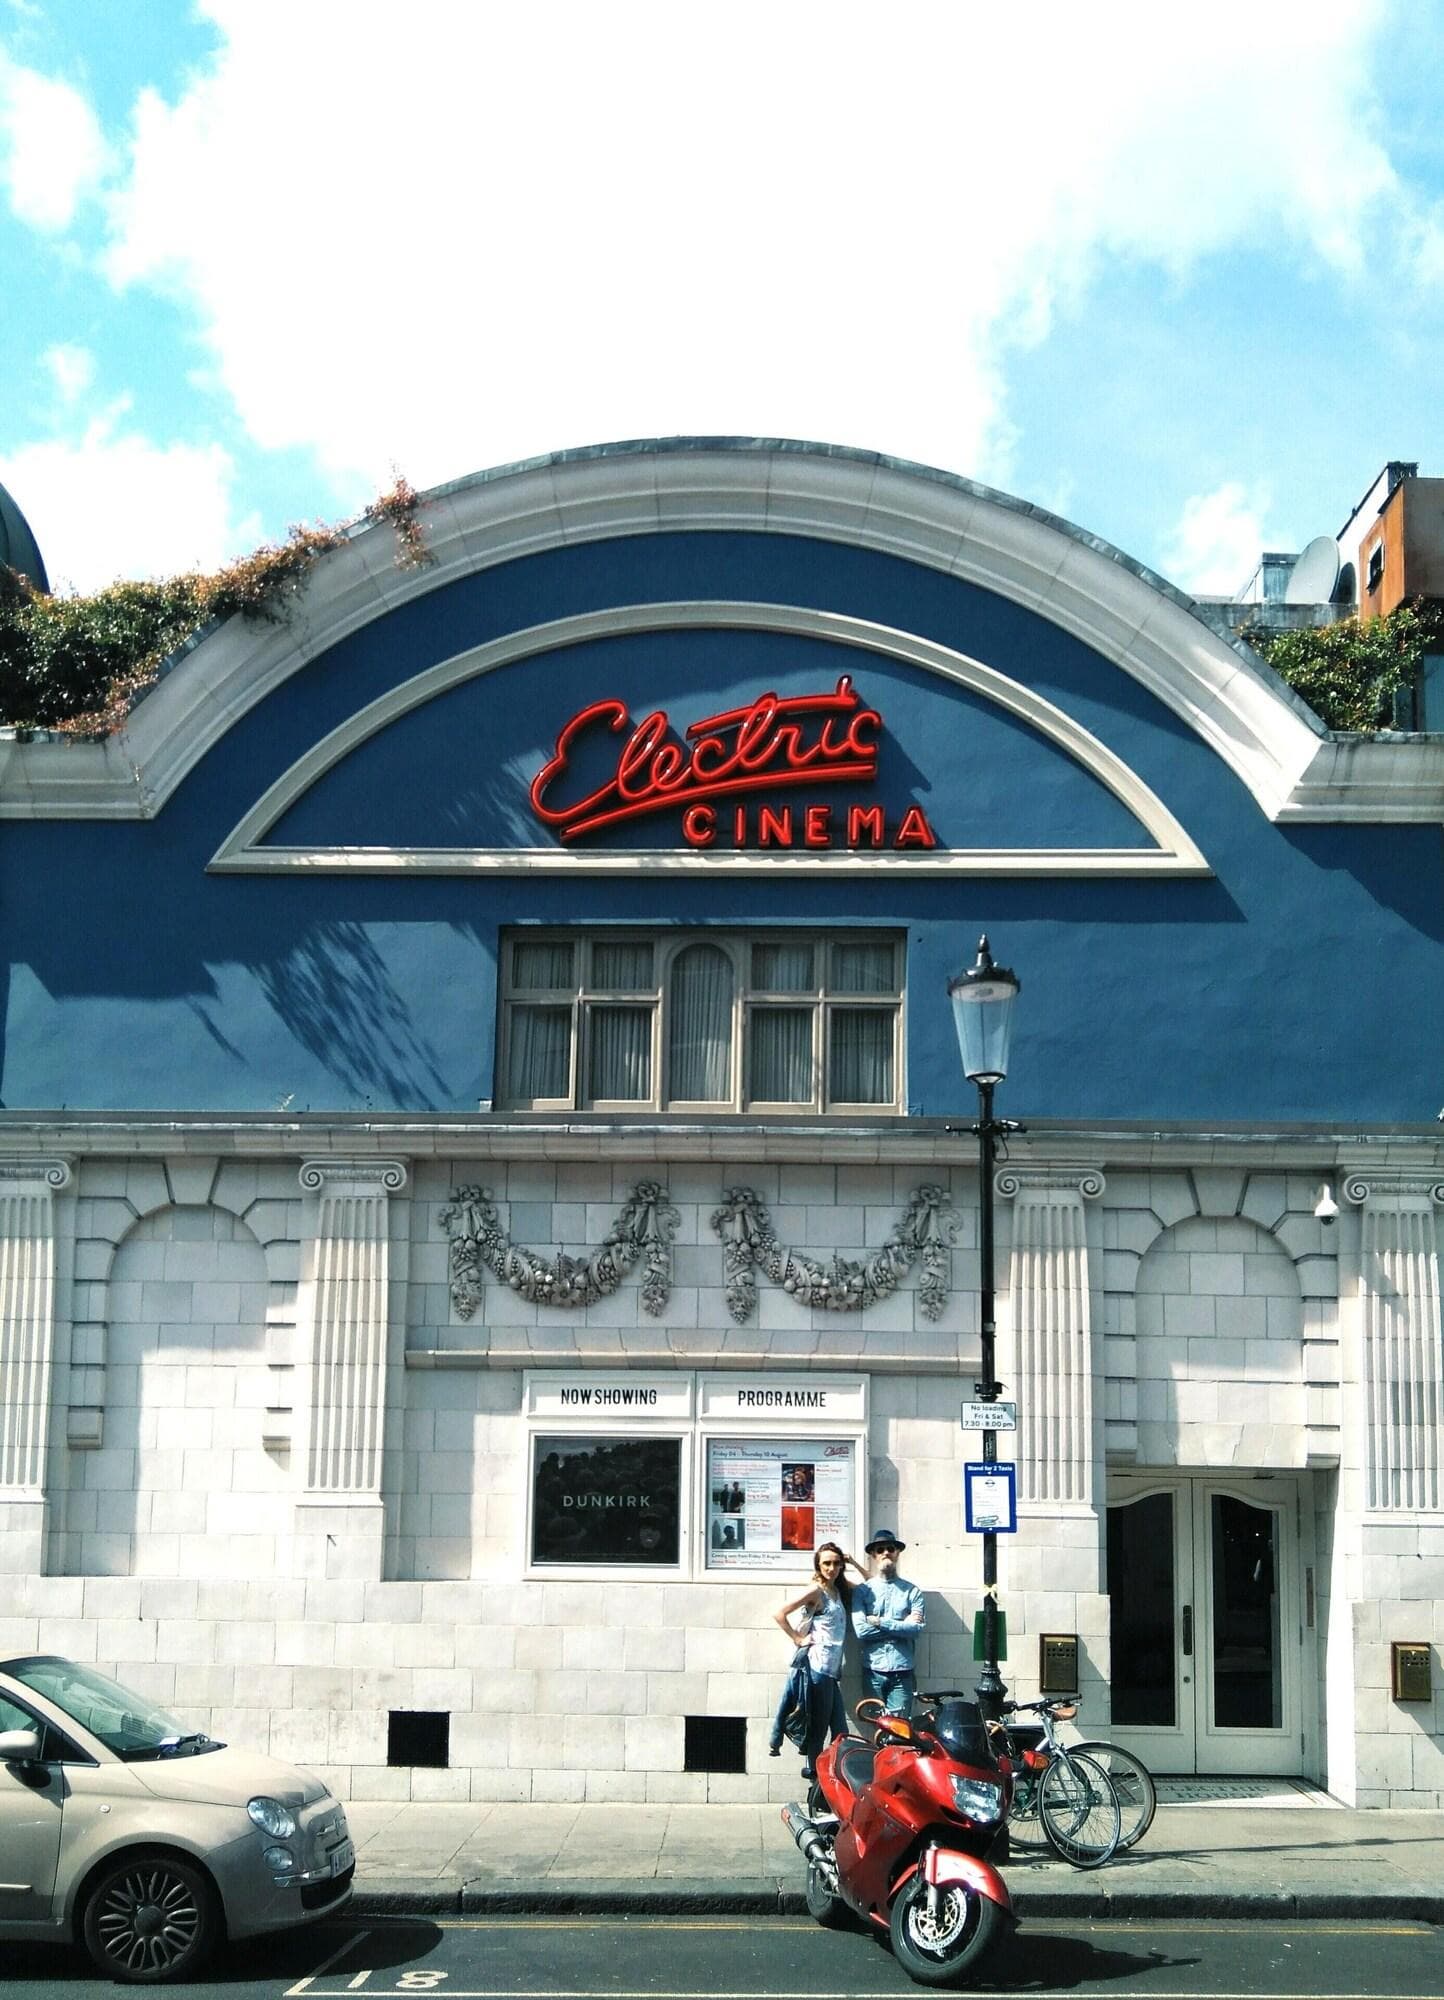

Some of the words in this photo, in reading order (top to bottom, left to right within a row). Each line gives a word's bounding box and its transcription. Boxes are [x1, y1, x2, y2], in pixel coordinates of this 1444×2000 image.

[529, 674, 882, 826] Electric
[682, 803, 936, 850] CINEMA
[561, 1388, 591, 1405] NOW
[594, 1389, 657, 1405] SHOWING
[738, 1390, 827, 1407] PROGRAMME
[981, 1404, 1007, 1412] loading
[563, 1495, 651, 1508] DUNKIRK
[346, 1970, 449, 1989] 18
